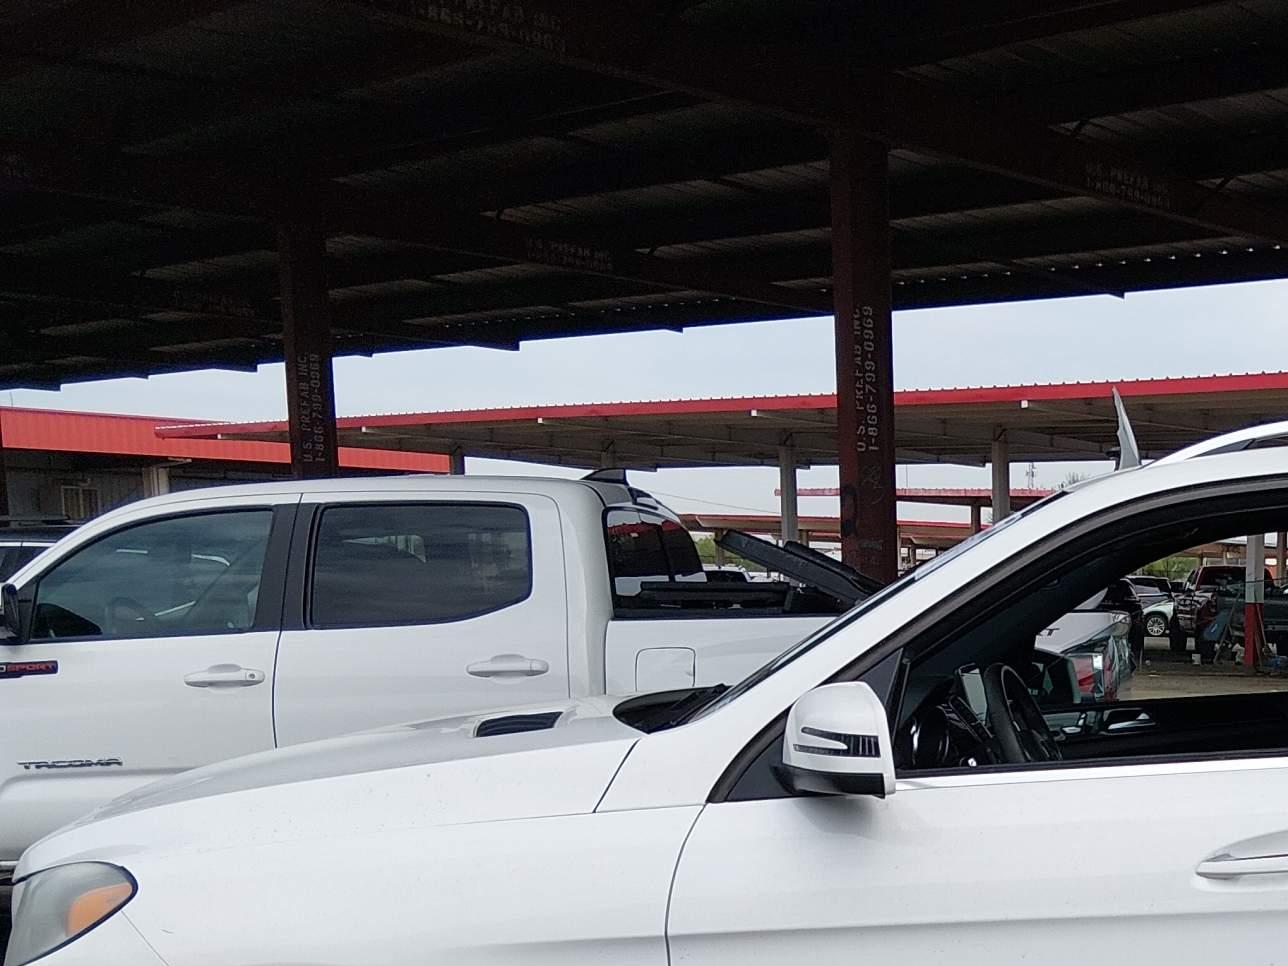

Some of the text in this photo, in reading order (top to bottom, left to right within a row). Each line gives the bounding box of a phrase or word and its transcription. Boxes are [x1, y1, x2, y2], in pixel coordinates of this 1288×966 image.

[862, 305, 880, 452] 1-866-799-0969
[299, 382, 312, 432] PREFAB
[17, 758, 123, 770] TACOMA
